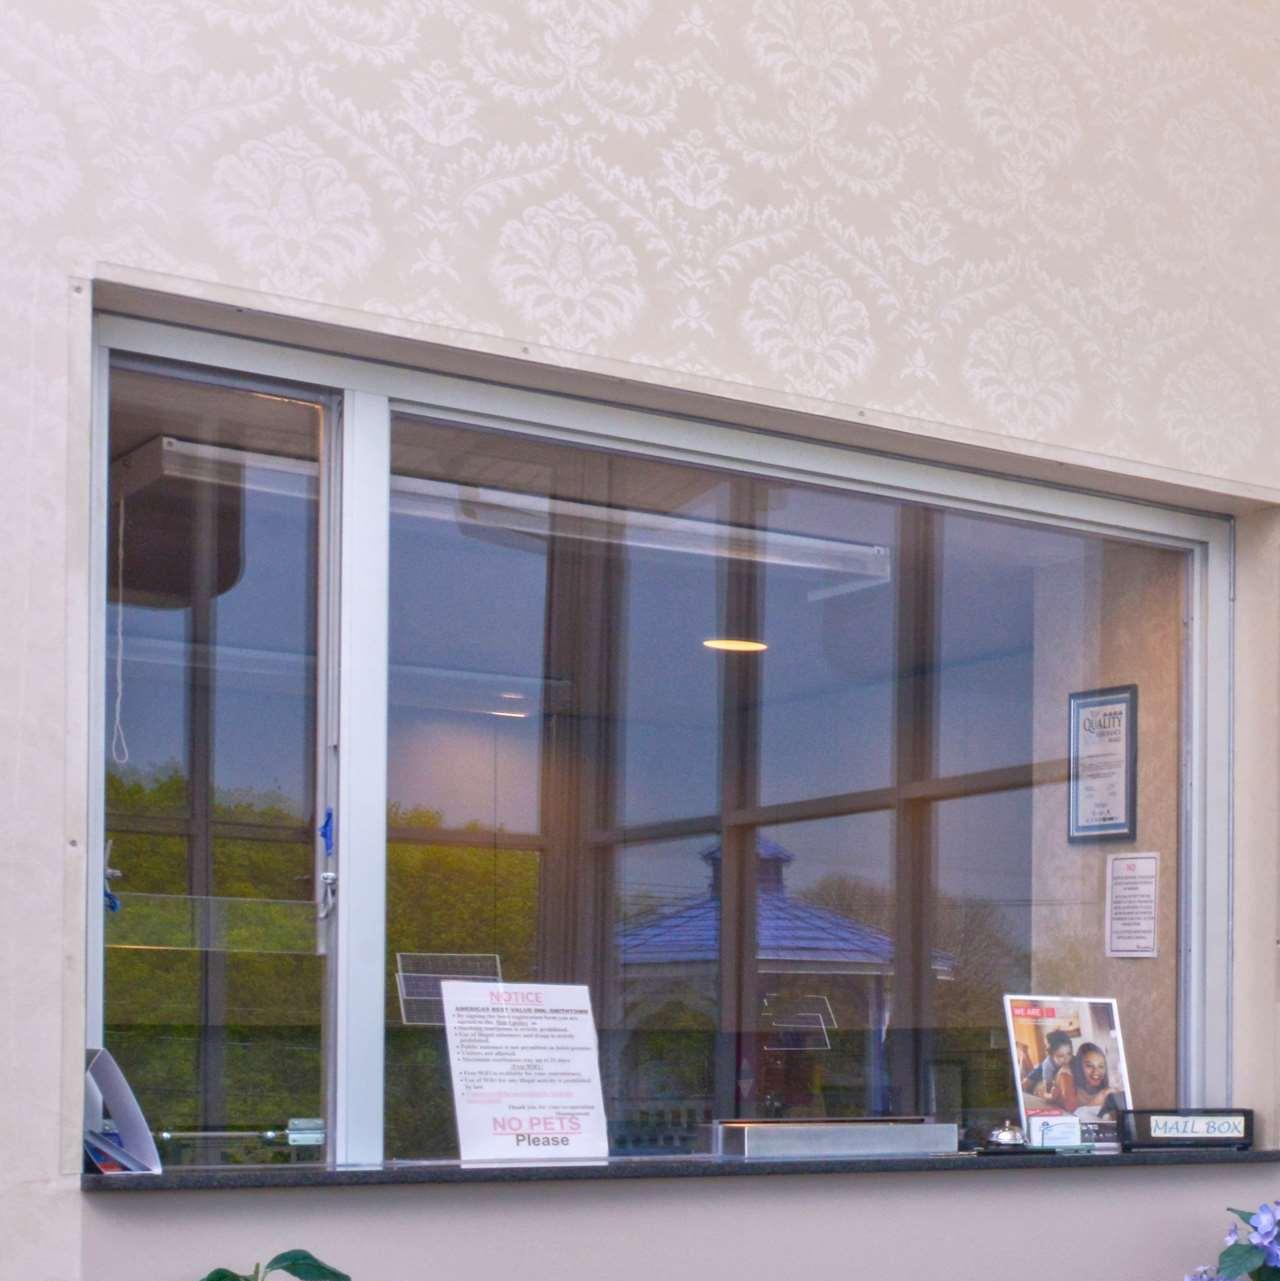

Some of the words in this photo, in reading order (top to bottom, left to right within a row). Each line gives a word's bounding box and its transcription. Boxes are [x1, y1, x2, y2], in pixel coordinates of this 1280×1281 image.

[1083, 715, 1121, 734] QUALITY
[489, 991, 544, 1003] NOTICE
[492, 1117, 522, 1131] NO
[529, 1116, 581, 1131] PETS
[1153, 1119, 1199, 1134] MAIL
[1206, 1120, 1242, 1134] BOX
[516, 1133, 570, 1146] Please
